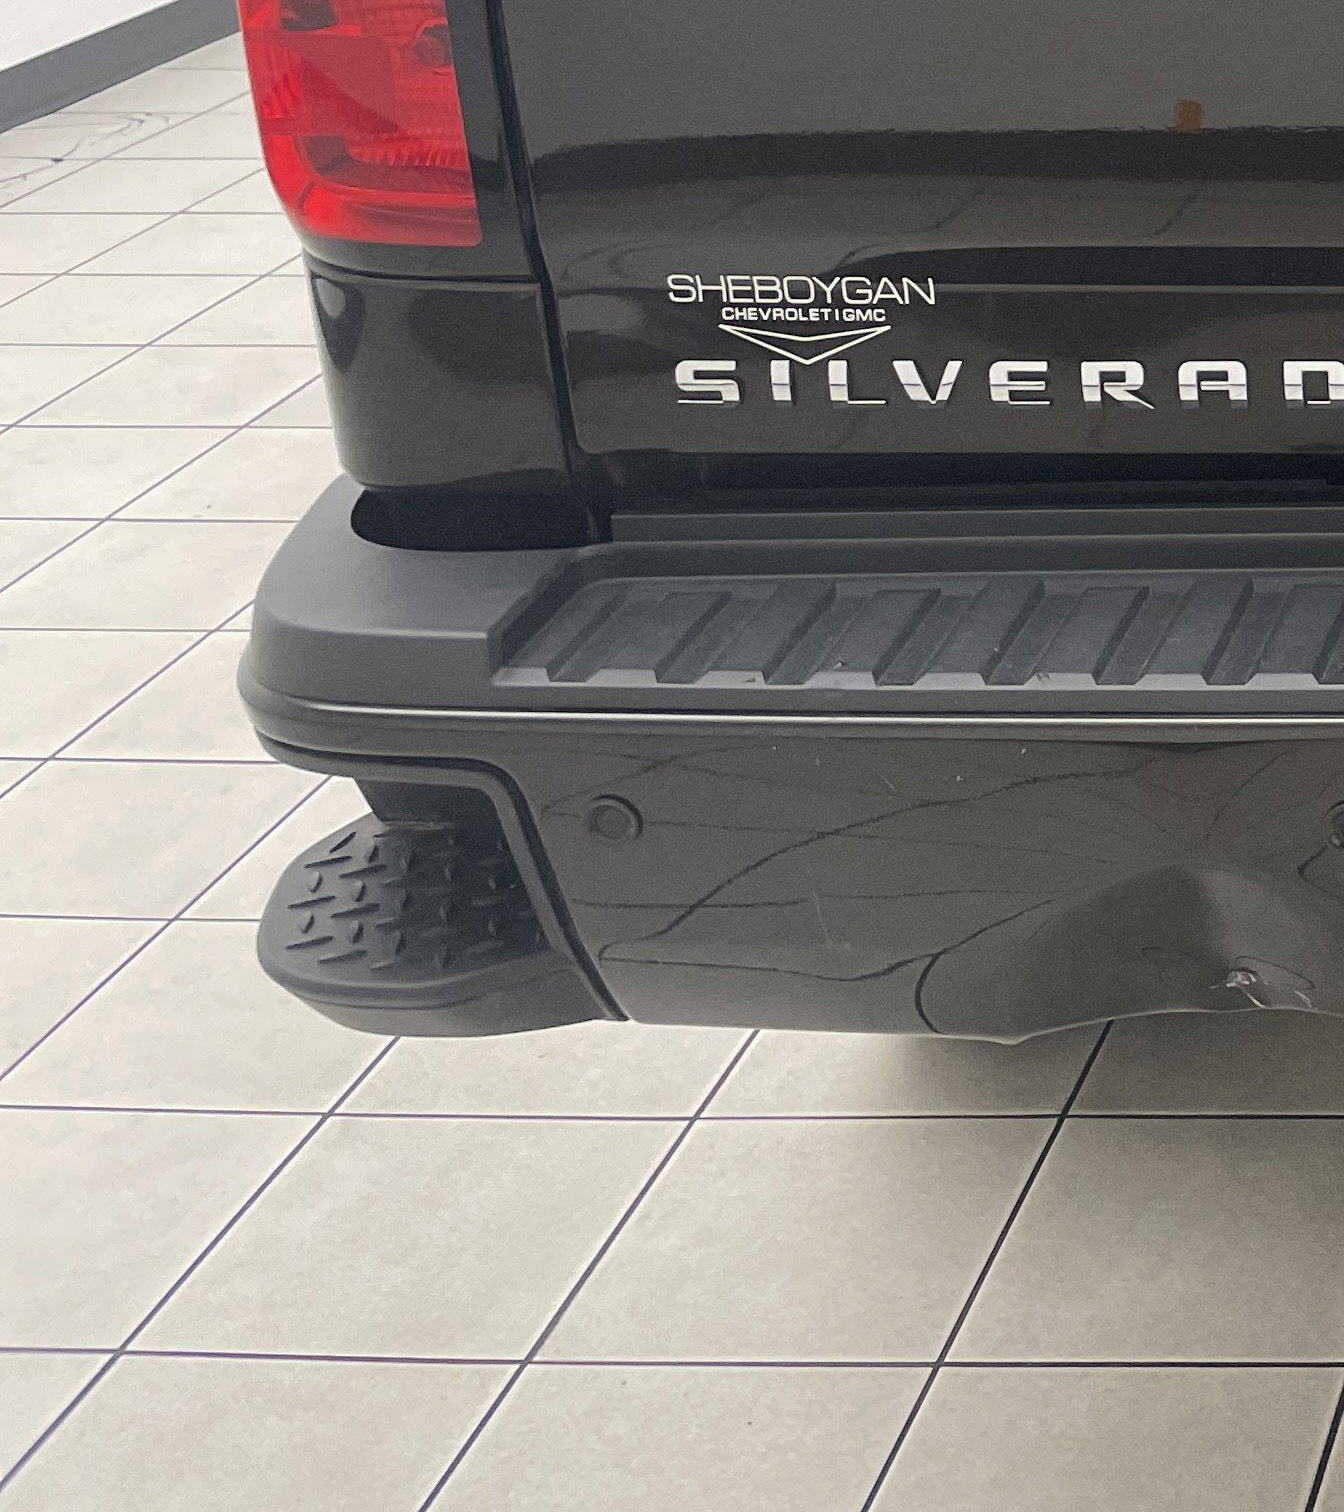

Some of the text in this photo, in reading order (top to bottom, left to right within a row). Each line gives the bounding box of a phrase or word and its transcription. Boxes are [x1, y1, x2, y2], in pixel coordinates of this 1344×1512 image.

[666, 273, 936, 306] SHEBOYGAN
[721, 306, 887, 323] CHEVROLET GMC
